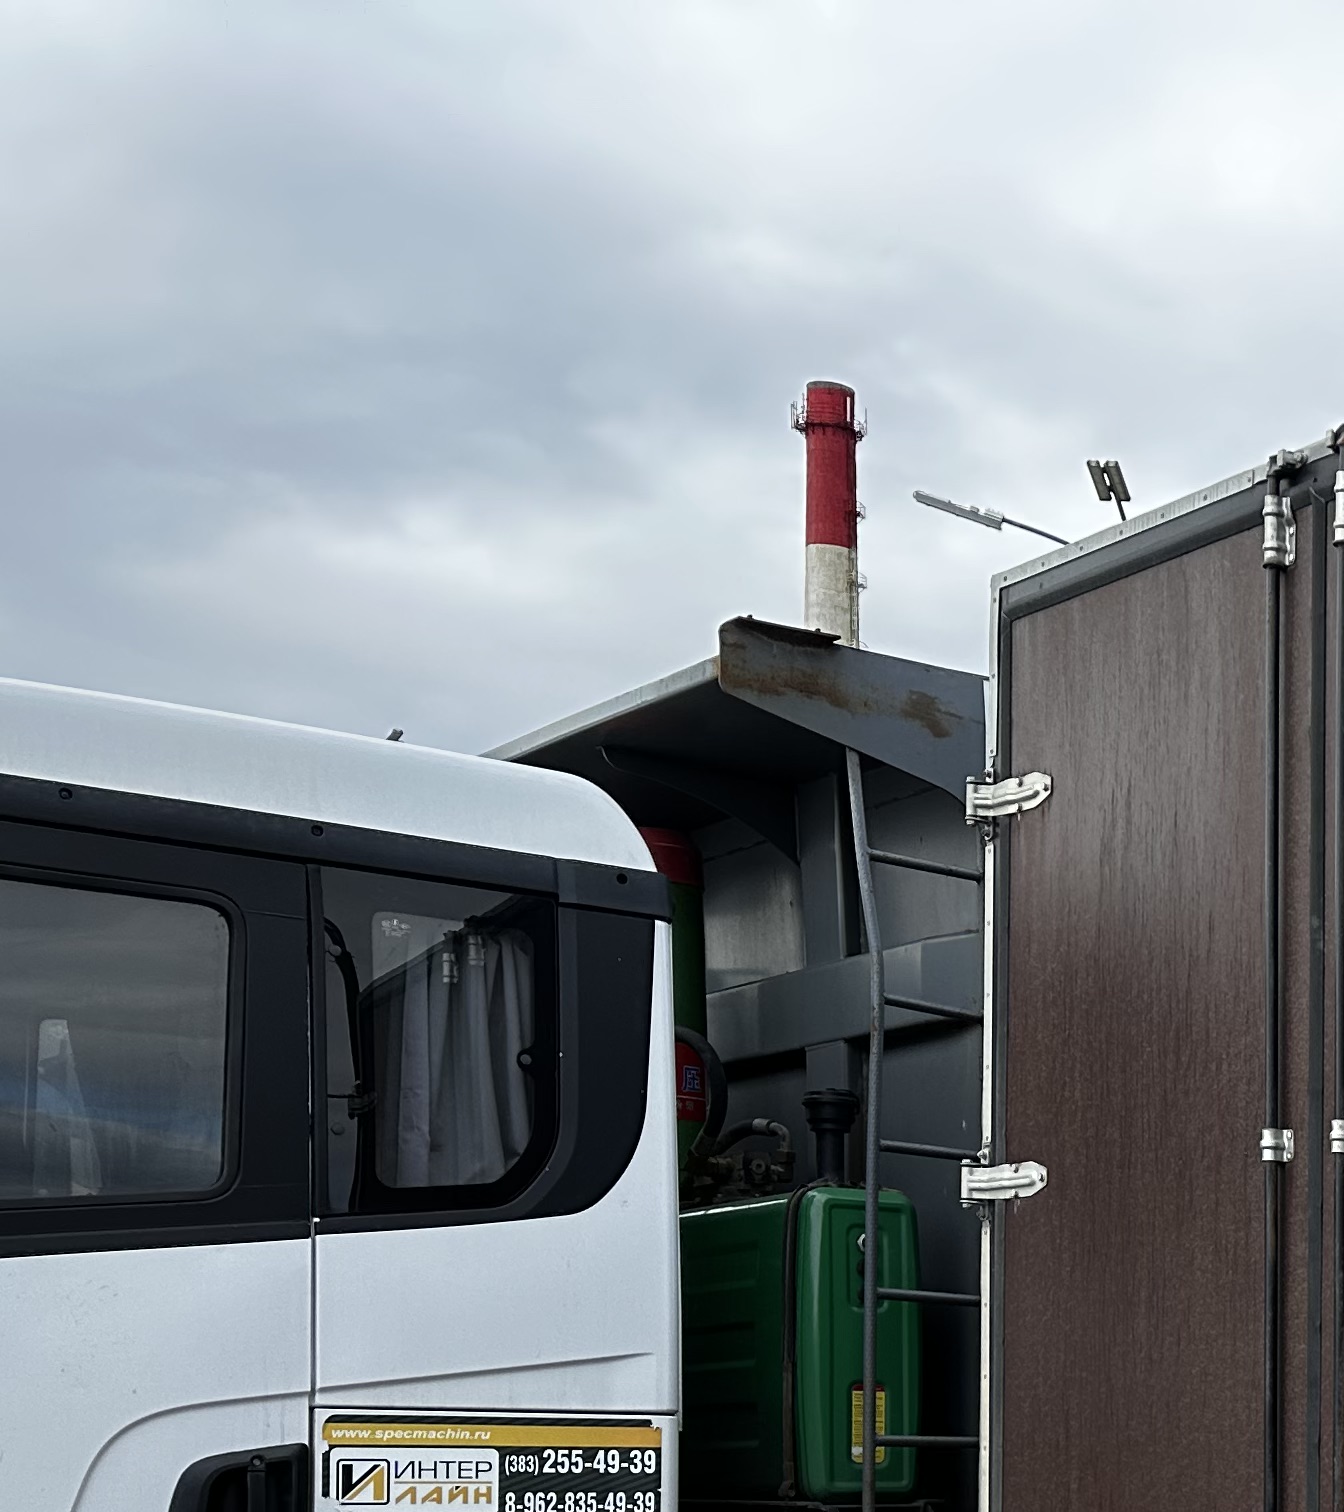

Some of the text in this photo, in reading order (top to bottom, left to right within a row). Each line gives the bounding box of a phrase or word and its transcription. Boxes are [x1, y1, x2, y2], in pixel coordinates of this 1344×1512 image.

[331, 1428, 491, 1441] www.specmachin.ru
[394, 1460, 493, 1480] ИНТЕР
[505, 1449, 657, 1476] (383) 255-49-39
[394, 1485, 493, 1505] ЛАЙН
